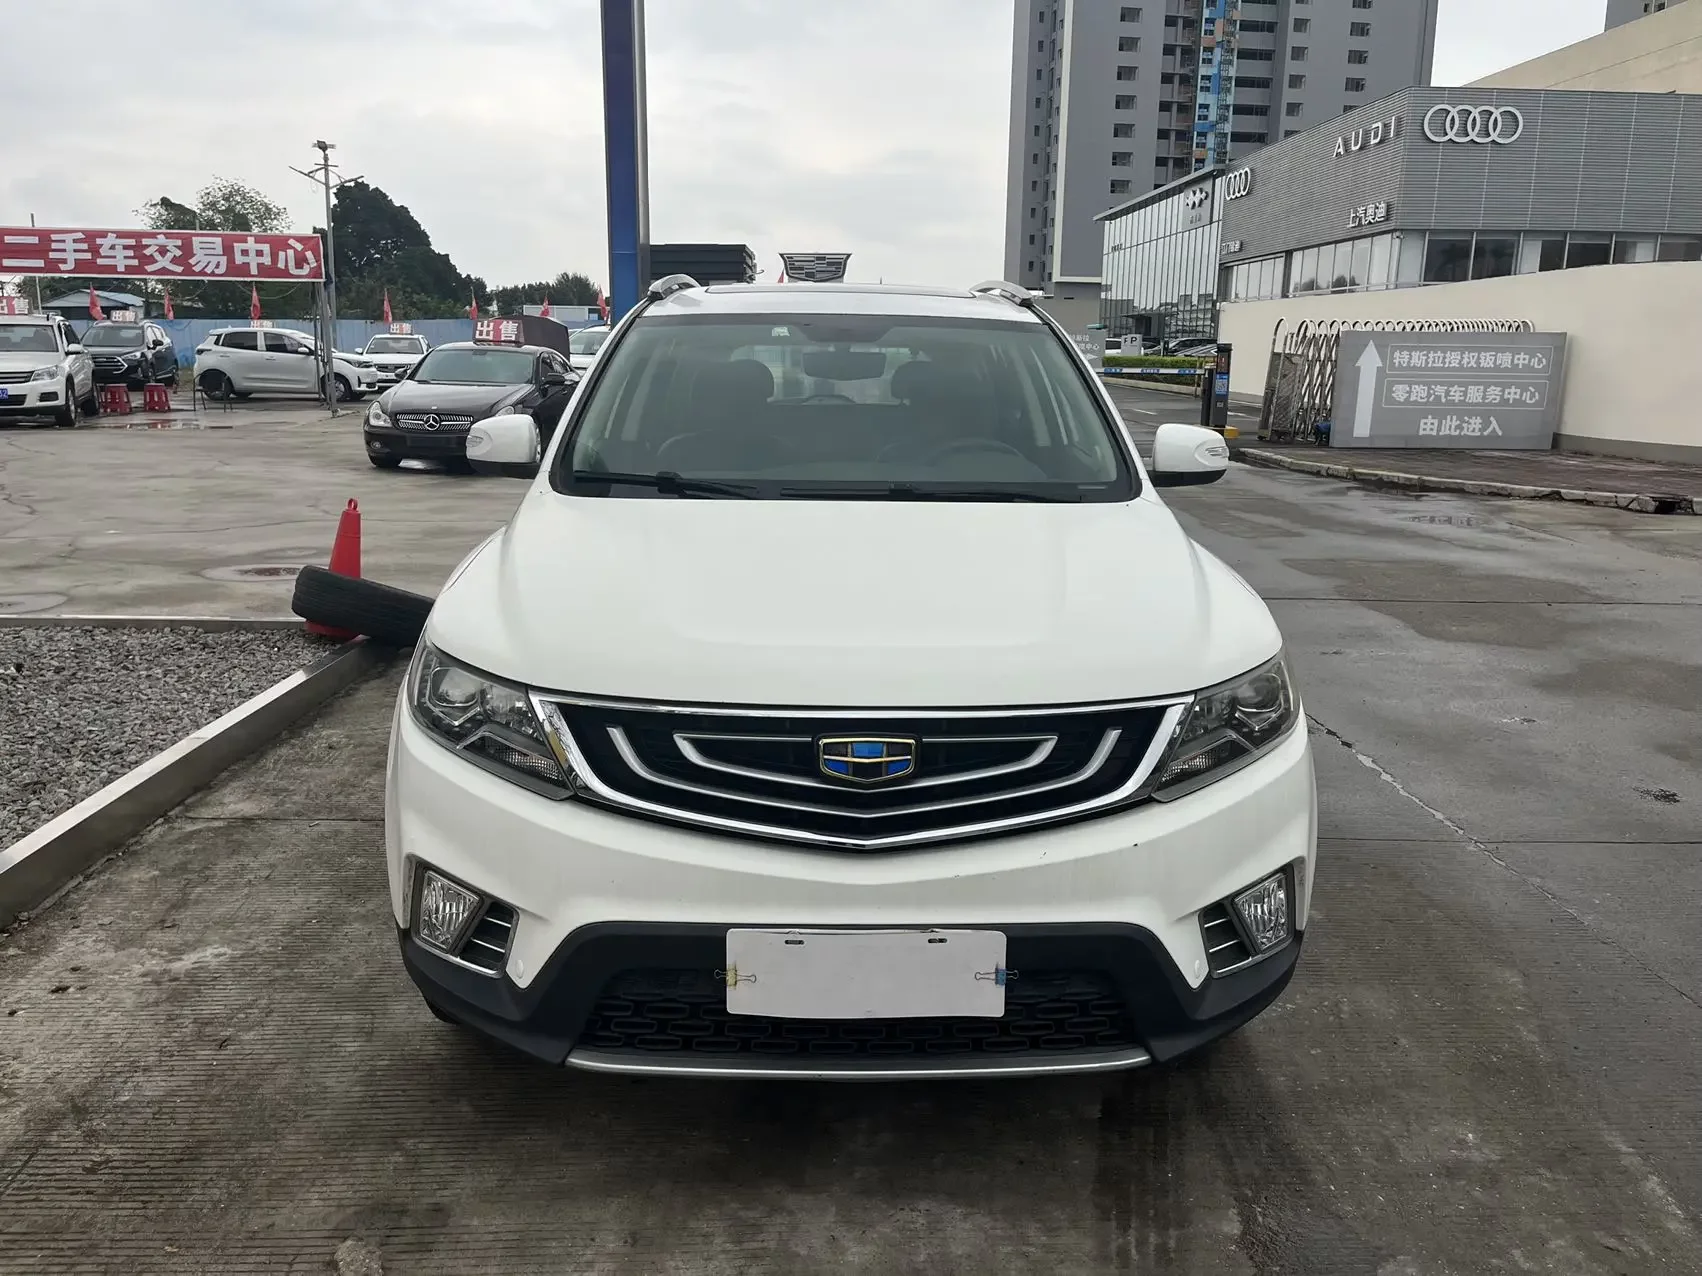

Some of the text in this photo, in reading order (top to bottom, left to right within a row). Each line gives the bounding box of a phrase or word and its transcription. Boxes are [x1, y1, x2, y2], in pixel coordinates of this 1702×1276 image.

[1332, 116, 1395, 157] AUDI
[1347, 201, 1387, 228] 上汽奥迪
[2, 233, 317, 275] 二手车交易中心
[475, 320, 519, 341] 出售
[1130, 336, 1138, 344] P
[1393, 350, 1547, 369] 特斯拉授权钣喷中心
[1391, 384, 1539, 404] 零跑汽车服务中心
[1418, 415, 1503, 437] 由此进入
